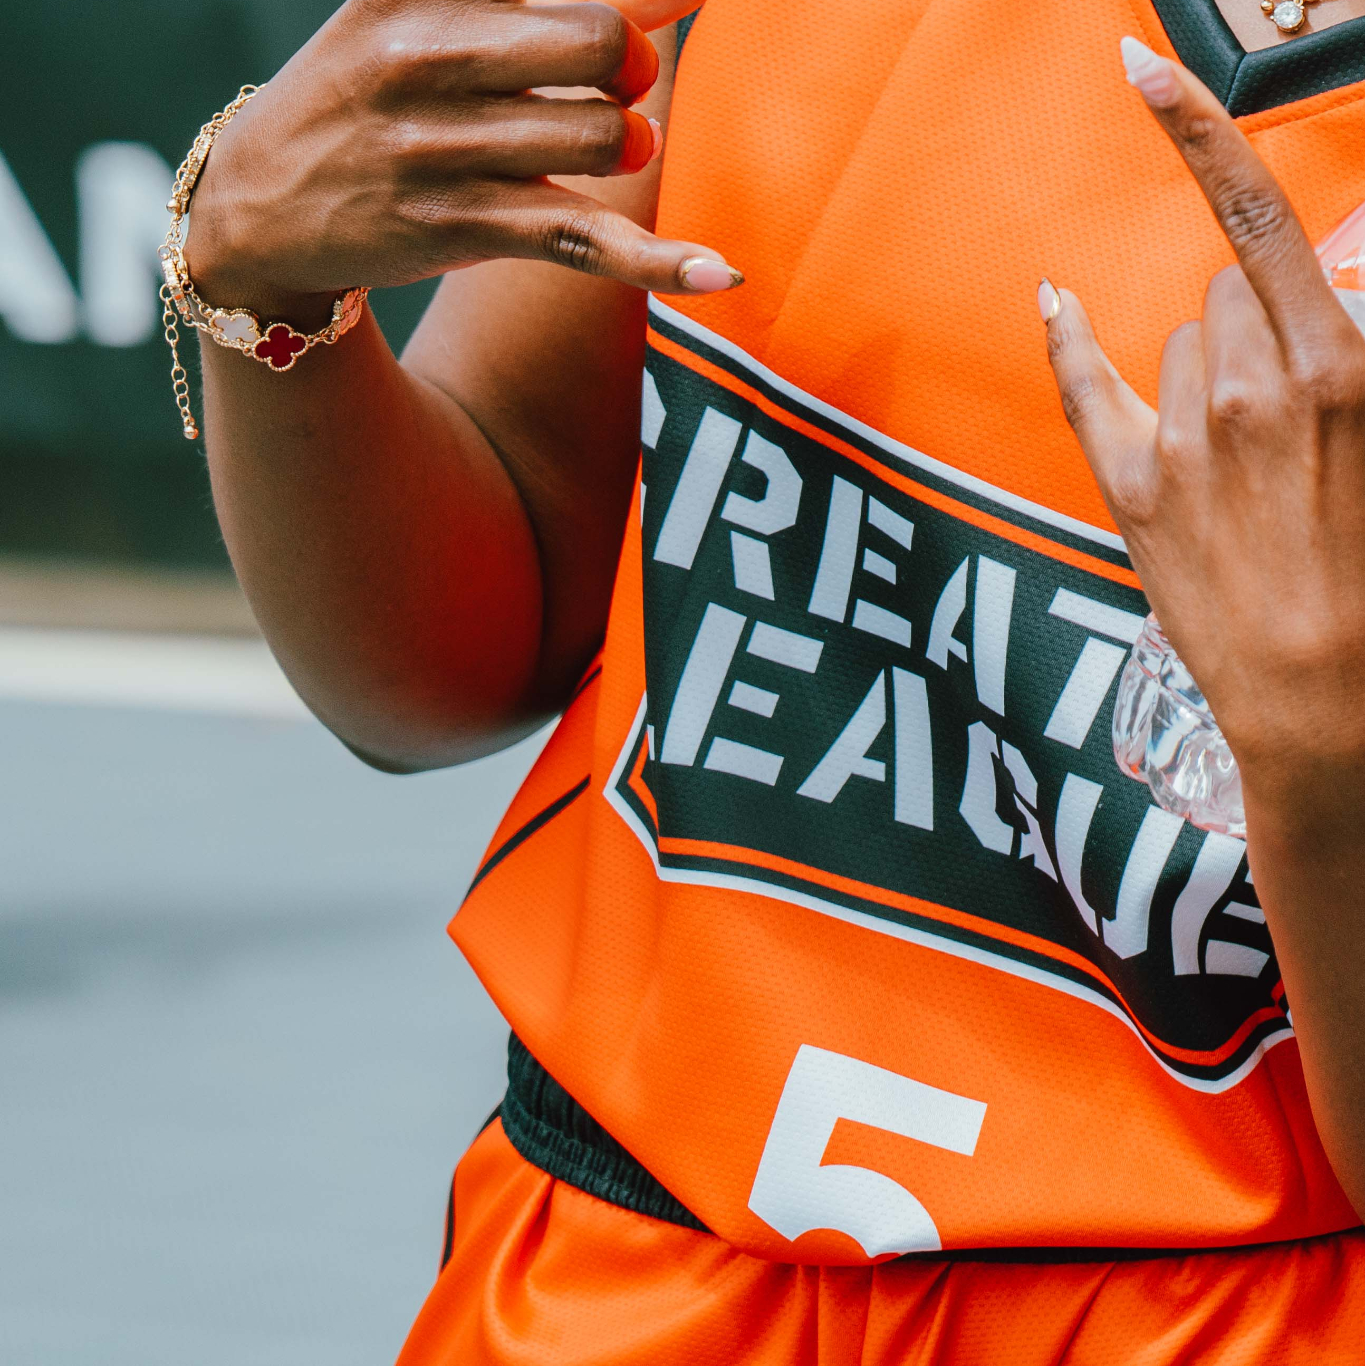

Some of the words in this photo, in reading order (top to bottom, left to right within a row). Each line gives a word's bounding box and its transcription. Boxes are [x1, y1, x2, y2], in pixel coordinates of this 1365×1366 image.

[641, 367, 1148, 750] REAT
[647, 602, 1270, 978] EAGUE
[747, 1044, 988, 1259] 5
